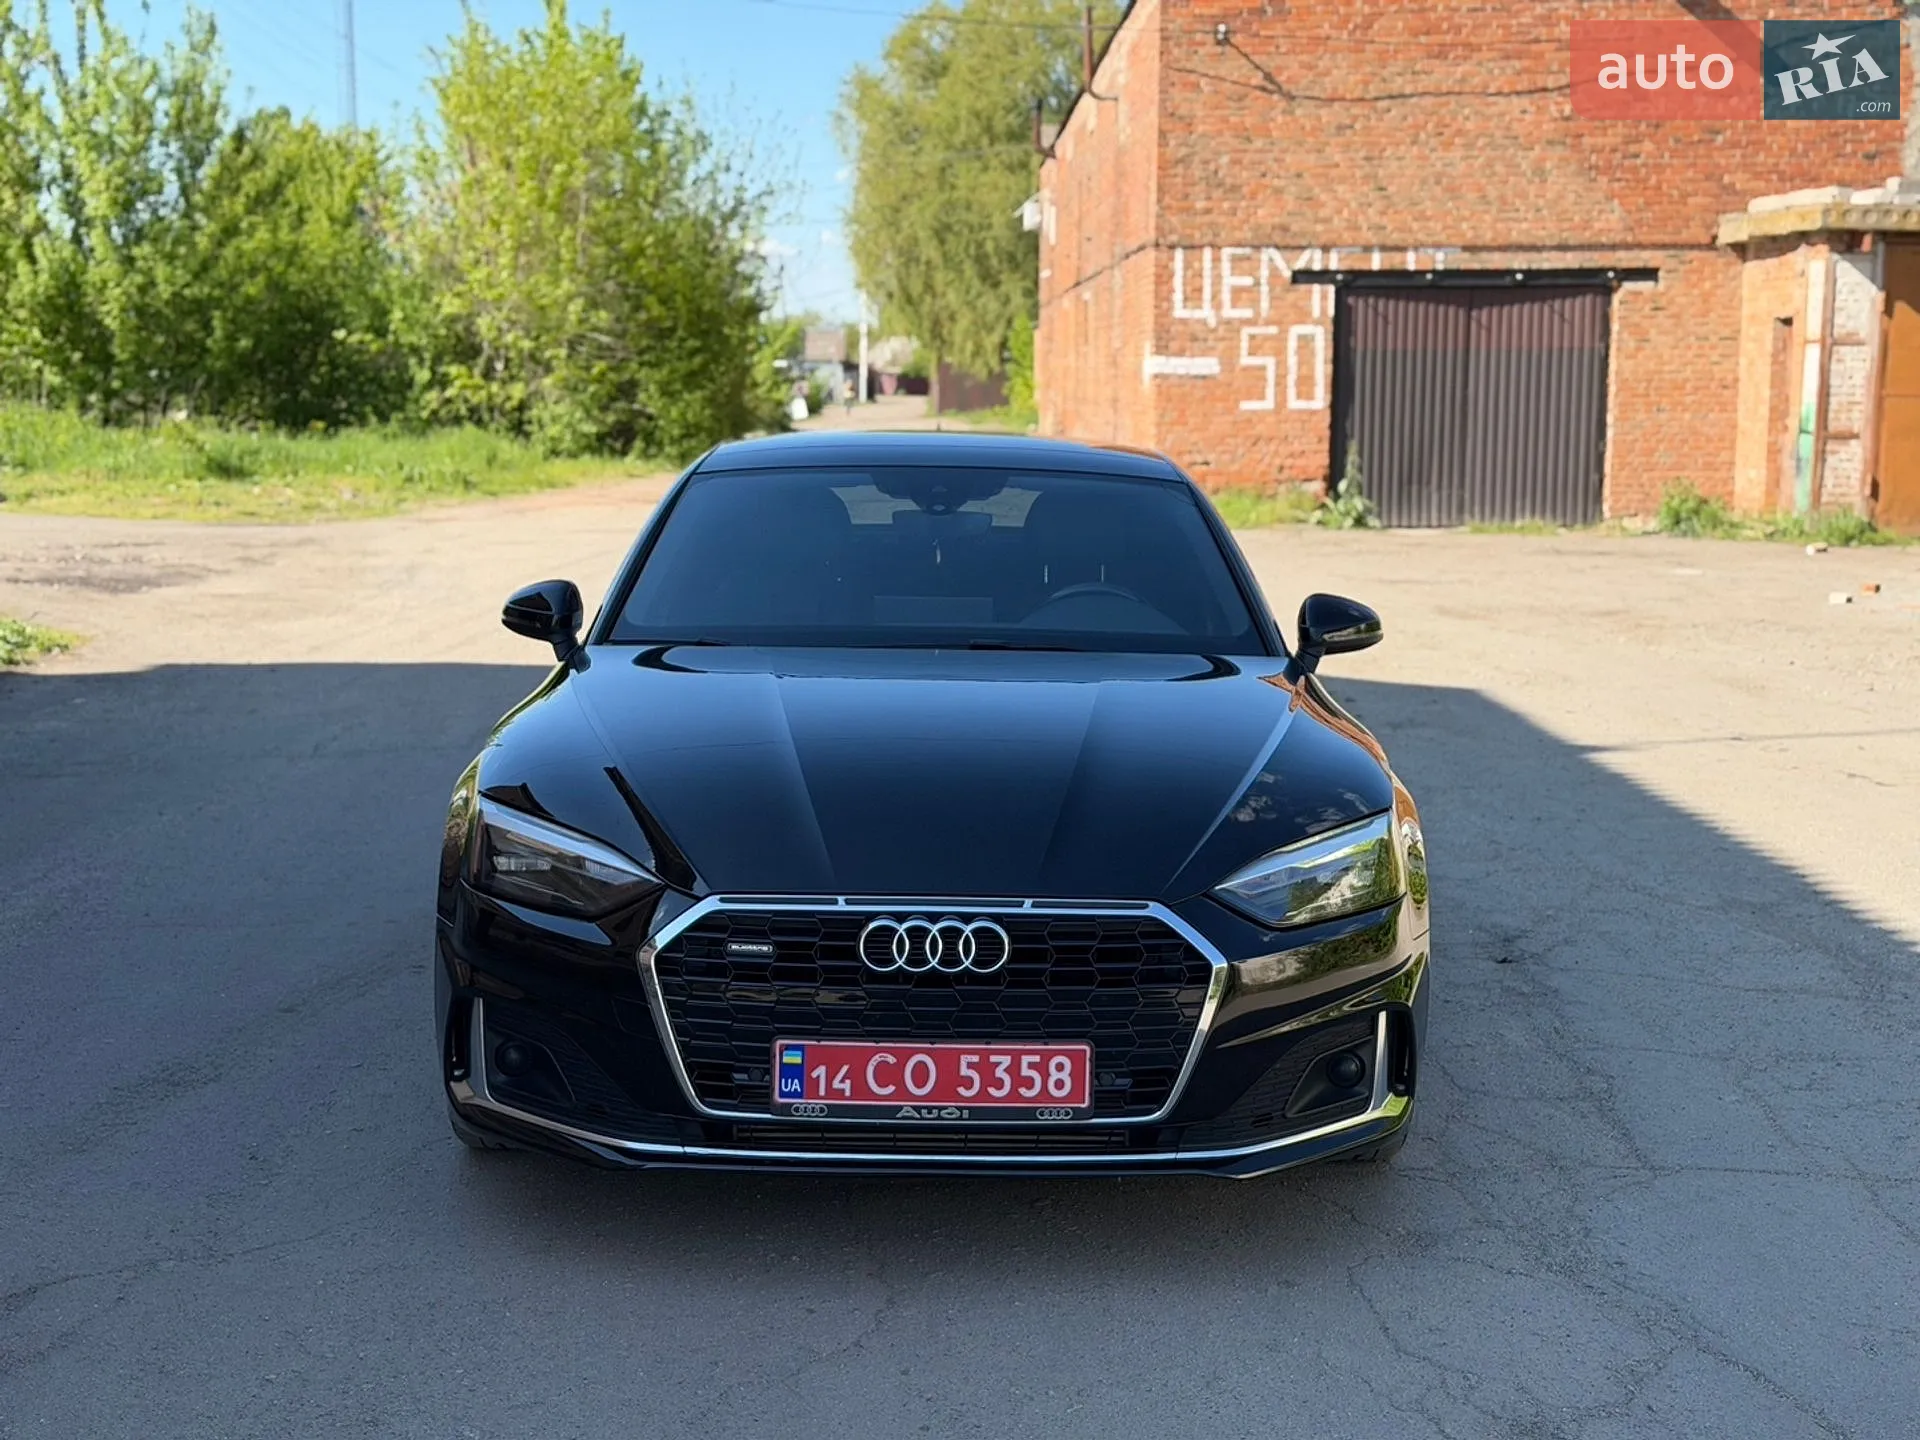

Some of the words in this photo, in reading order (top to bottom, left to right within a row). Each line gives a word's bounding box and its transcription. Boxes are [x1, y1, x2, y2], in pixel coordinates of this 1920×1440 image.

[1239, 325, 1325, 409] 50
[781, 1078, 801, 1093] UA
[811, 1064, 851, 1096] 14
[866, 1053, 937, 1096] CO
[956, 1054, 1072, 1098] 5358
